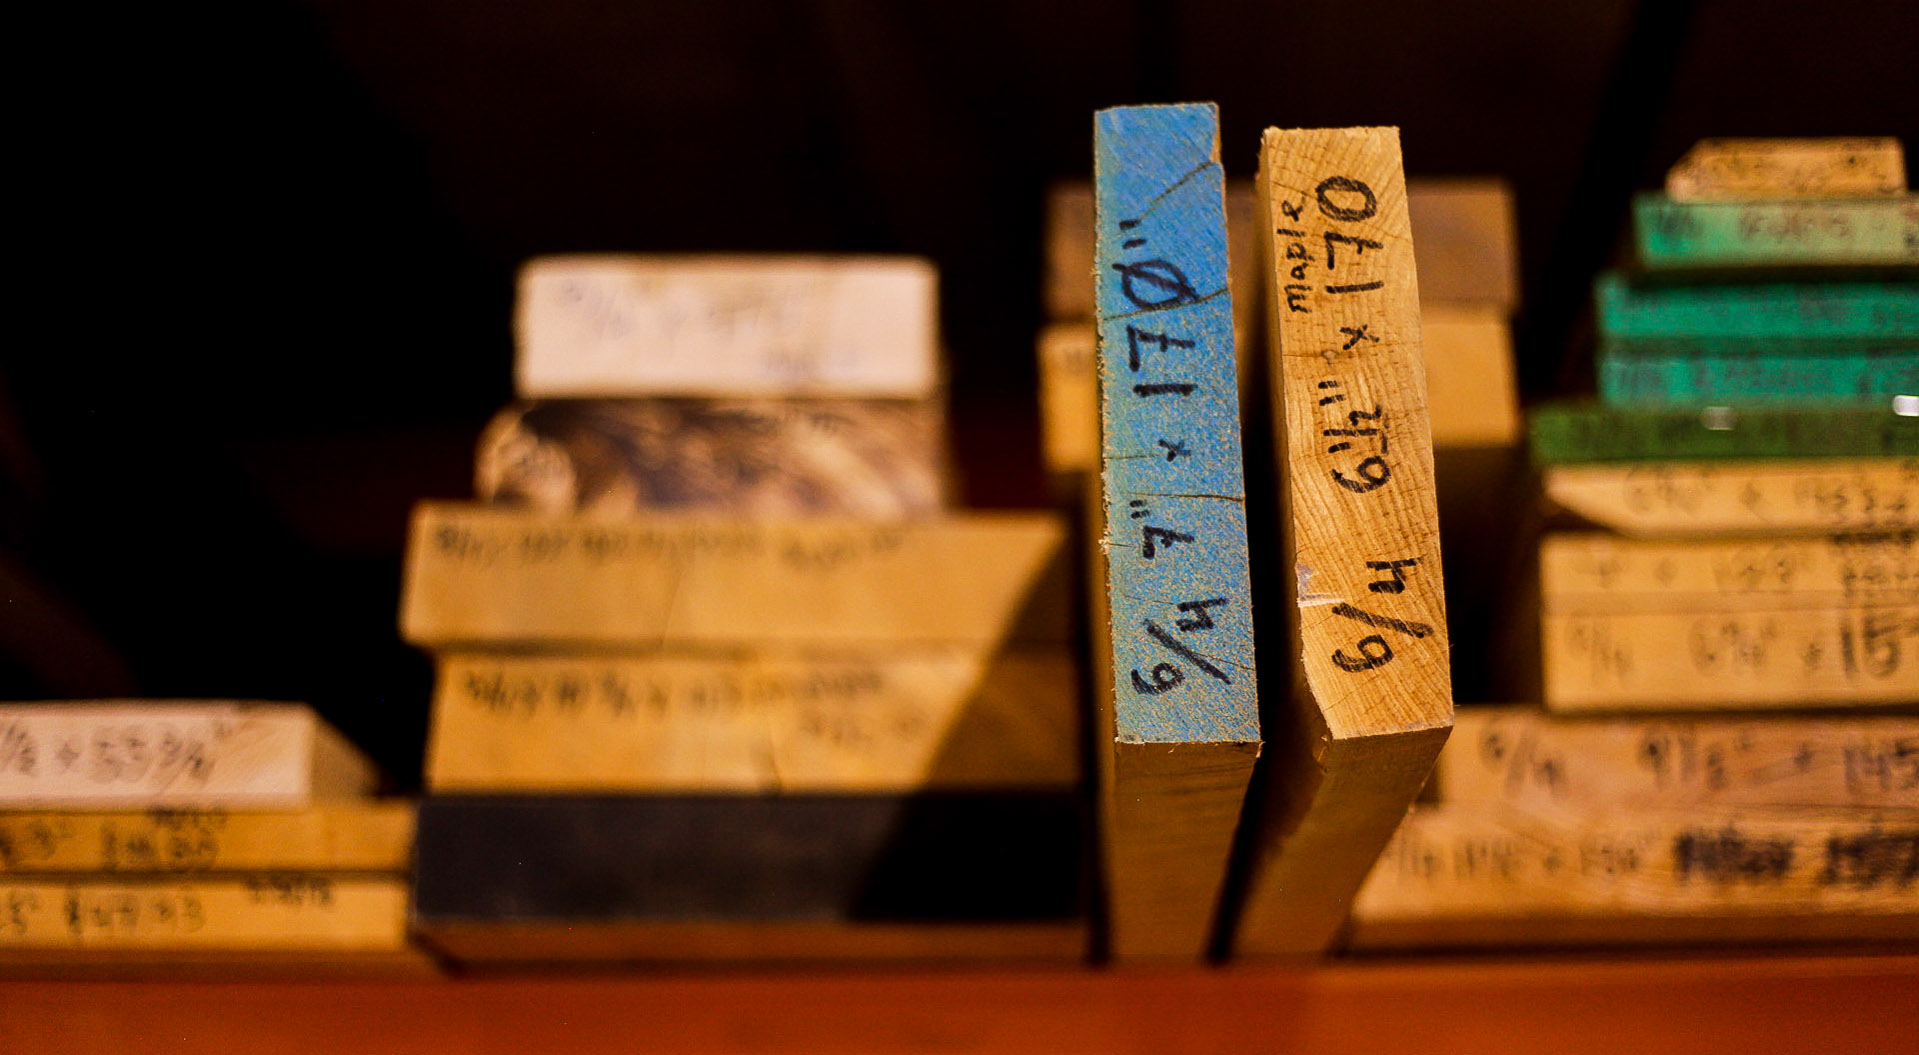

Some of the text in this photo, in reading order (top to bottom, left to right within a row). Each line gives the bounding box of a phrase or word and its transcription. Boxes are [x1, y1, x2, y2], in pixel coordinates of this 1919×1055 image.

[1315, 175, 1379, 295] 170
[1129, 595, 1231, 696] 6/4
[1330, 556, 1435, 673] 6/4
